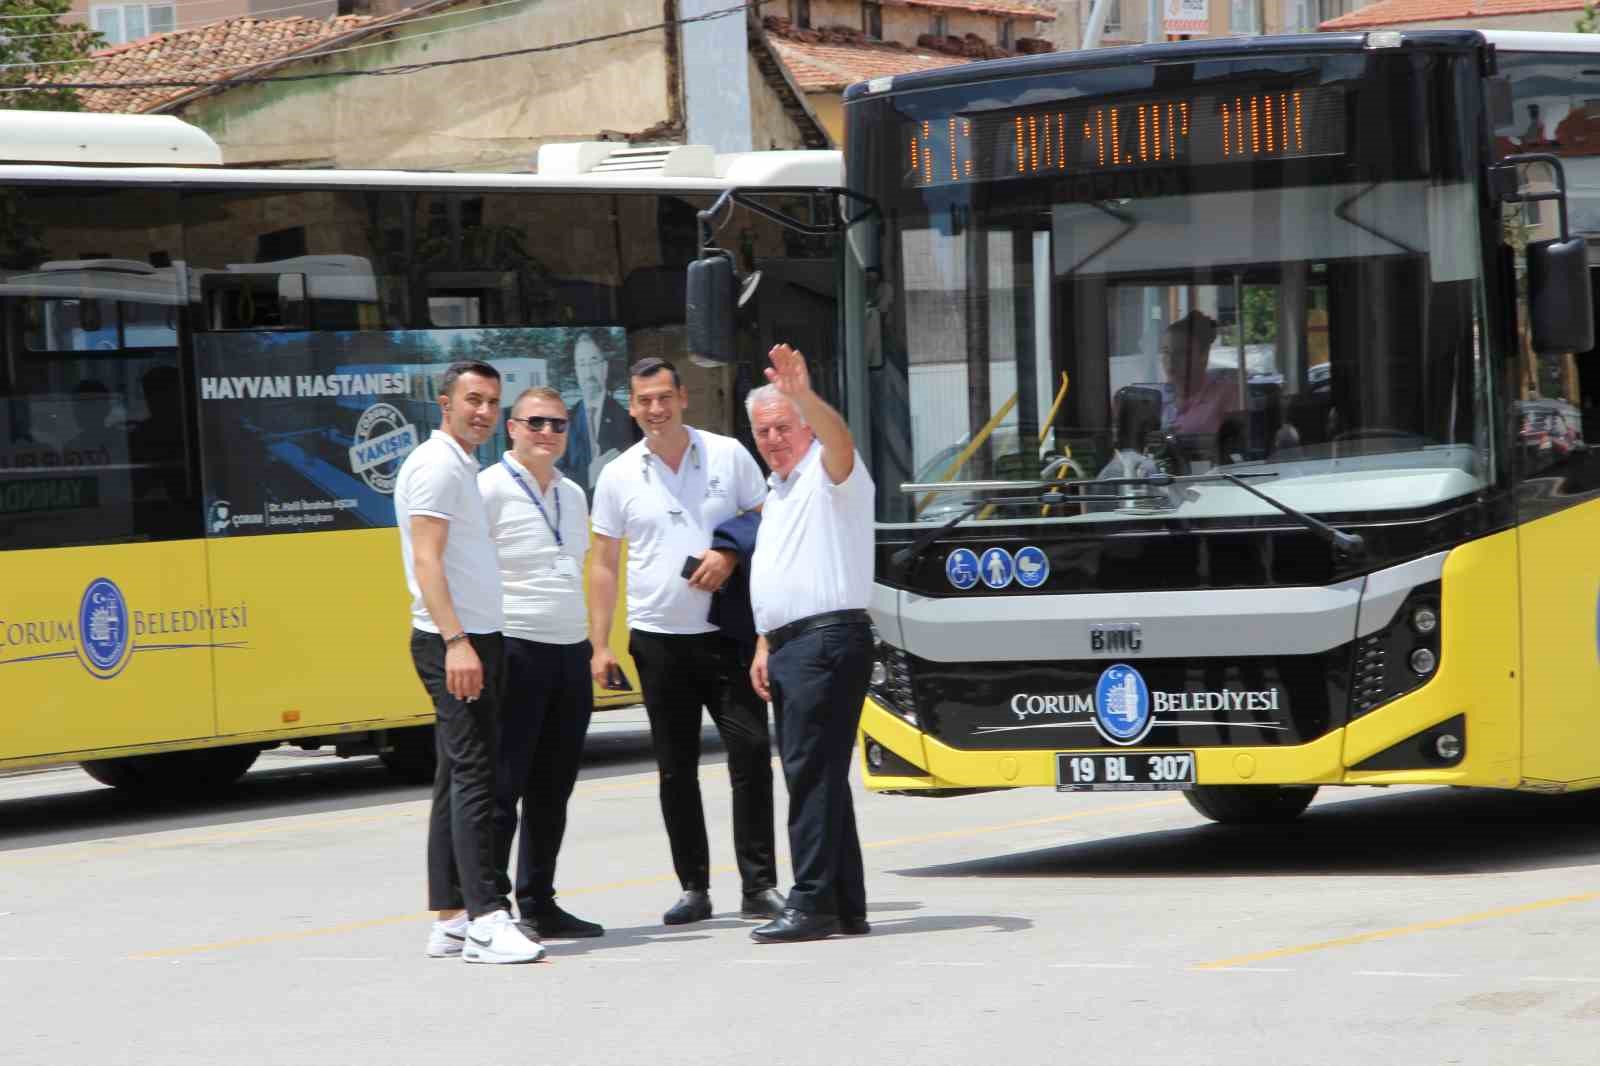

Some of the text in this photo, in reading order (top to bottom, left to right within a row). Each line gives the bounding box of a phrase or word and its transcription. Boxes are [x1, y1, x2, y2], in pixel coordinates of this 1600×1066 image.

[201, 376, 292, 399] HAYVAN
[355, 431, 414, 465] YAKIŞIR
[133, 600, 249, 635] BELEDİYESİ
[1089, 624, 1142, 652] BMC
[1010, 687, 1279, 720] ÇORUM BELEDİYESİ
[1070, 755, 1190, 782] 19 BL 307
